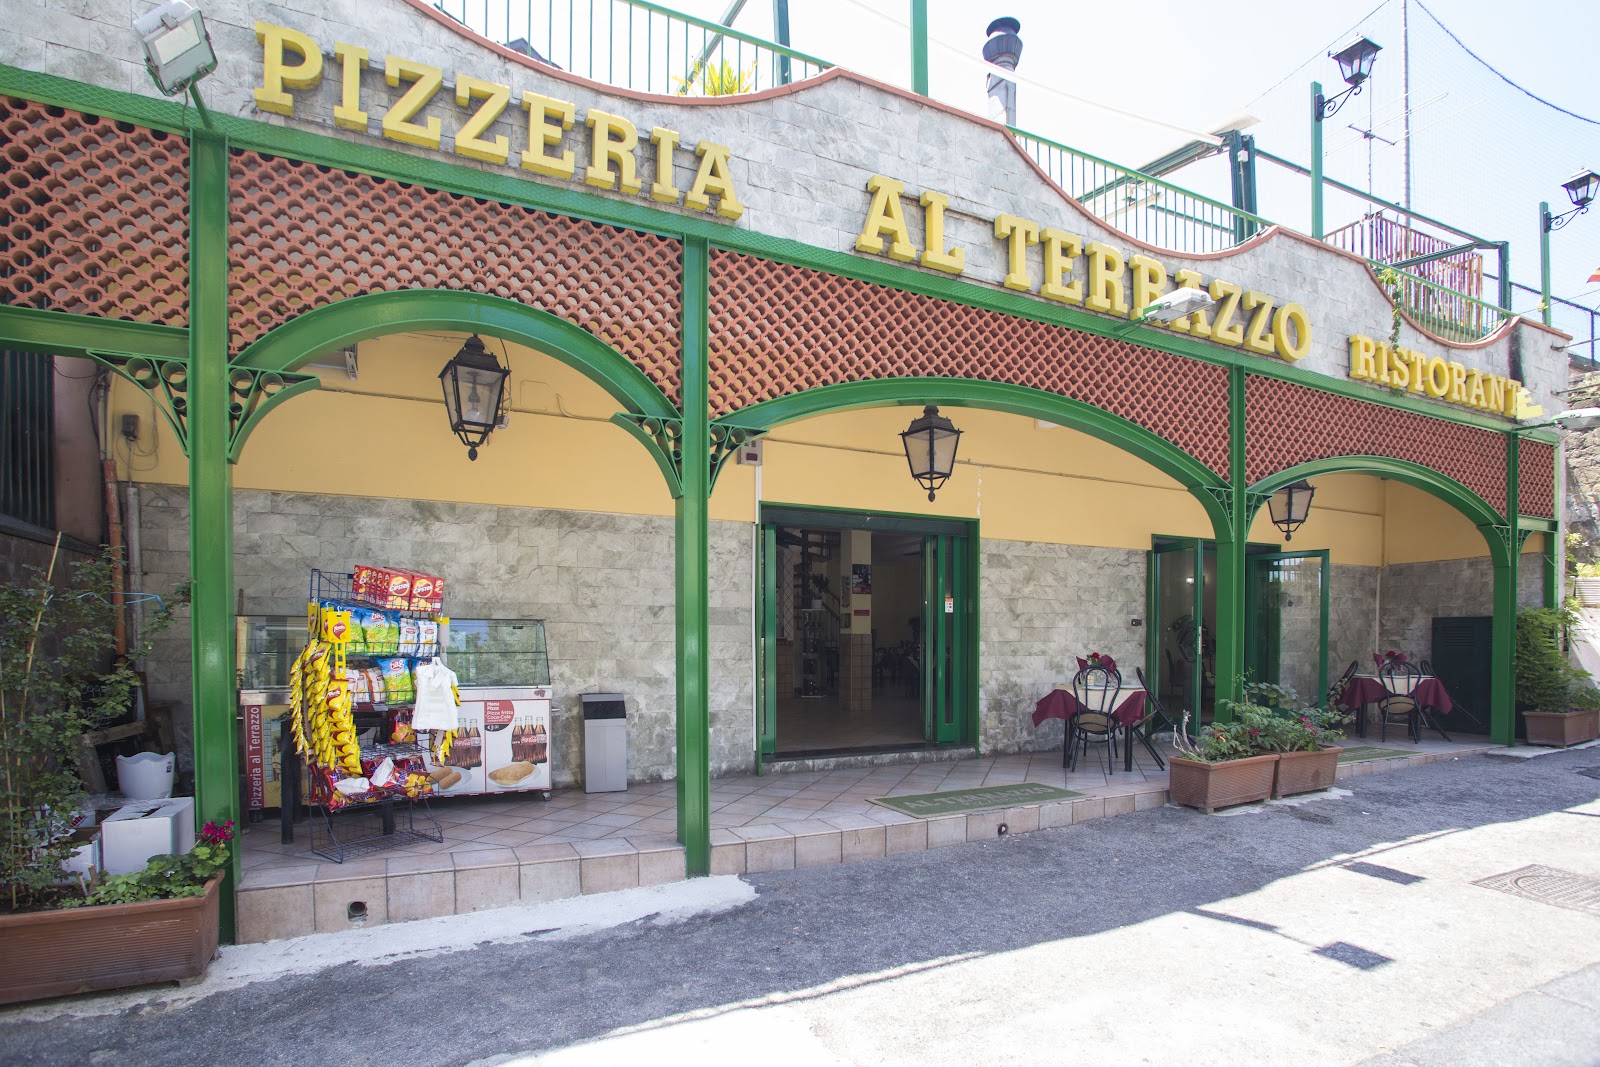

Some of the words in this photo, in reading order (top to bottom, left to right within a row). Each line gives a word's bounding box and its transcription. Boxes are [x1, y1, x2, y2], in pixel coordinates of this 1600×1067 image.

[255, 20, 743, 219] PIZZERIA
[855, 175, 965, 274] AL
[994, 214, 1312, 362] TERRAZZO
[1348, 334, 1543, 419] RISTORANTE
[249, 706, 260, 751] Terrazzo
[249, 755, 261, 764] al
[249, 767, 262, 807] Pizzeria
